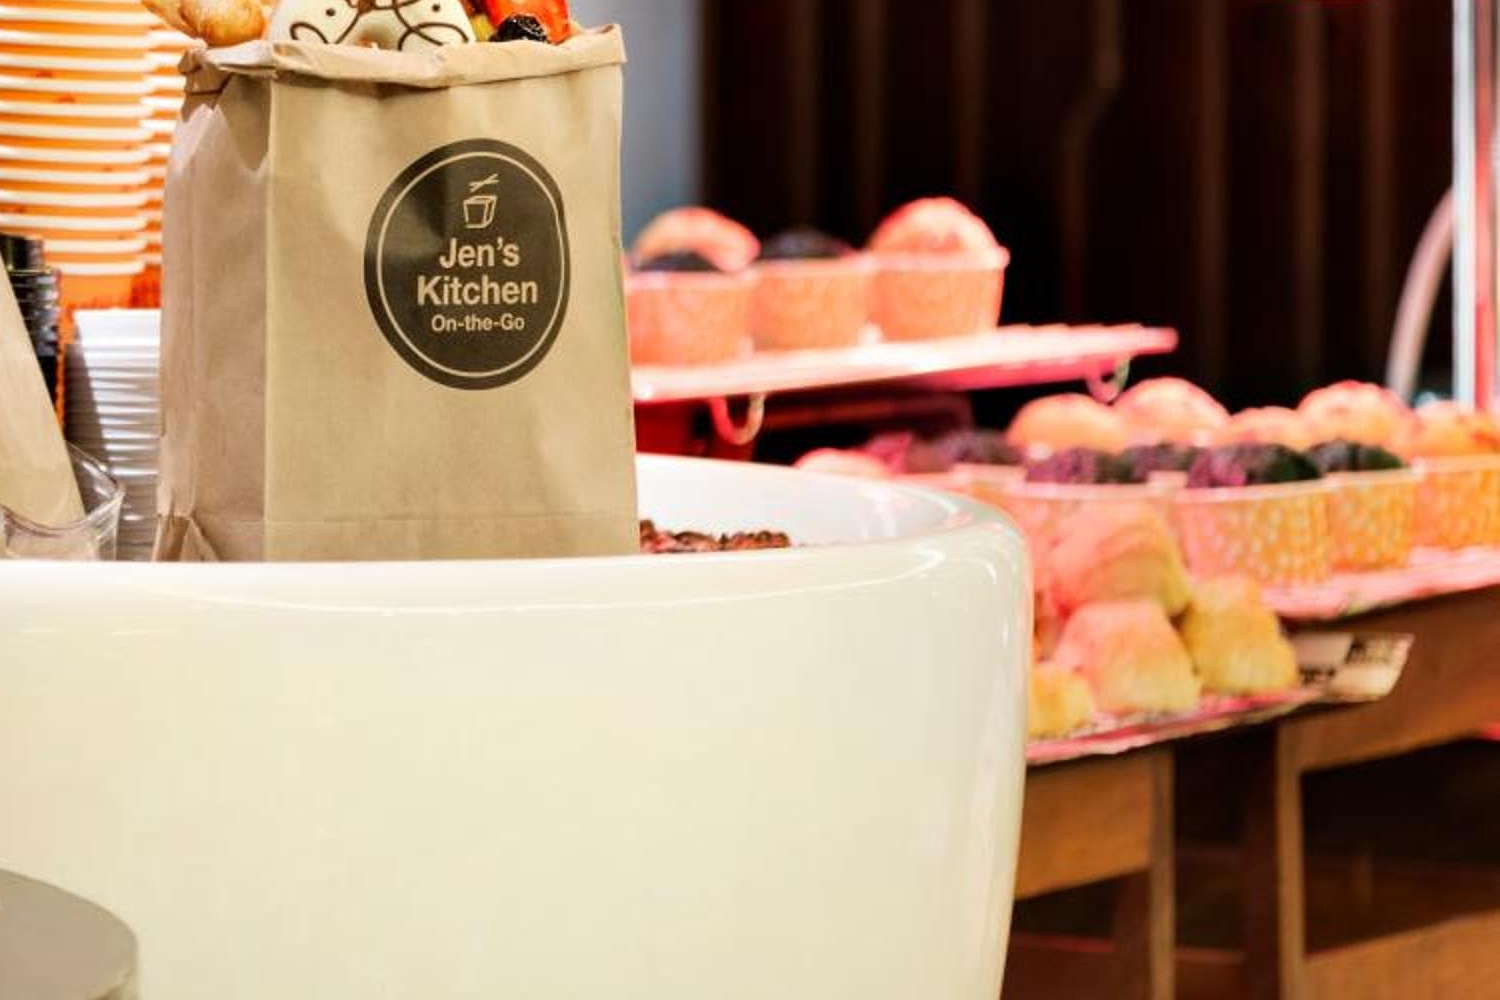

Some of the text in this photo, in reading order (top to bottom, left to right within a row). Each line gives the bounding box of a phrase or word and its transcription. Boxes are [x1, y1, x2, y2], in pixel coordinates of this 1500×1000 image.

[439, 237, 521, 269] Jen's
[416, 274, 539, 306] Kitchen
[430, 312, 526, 333] On-the-Go
